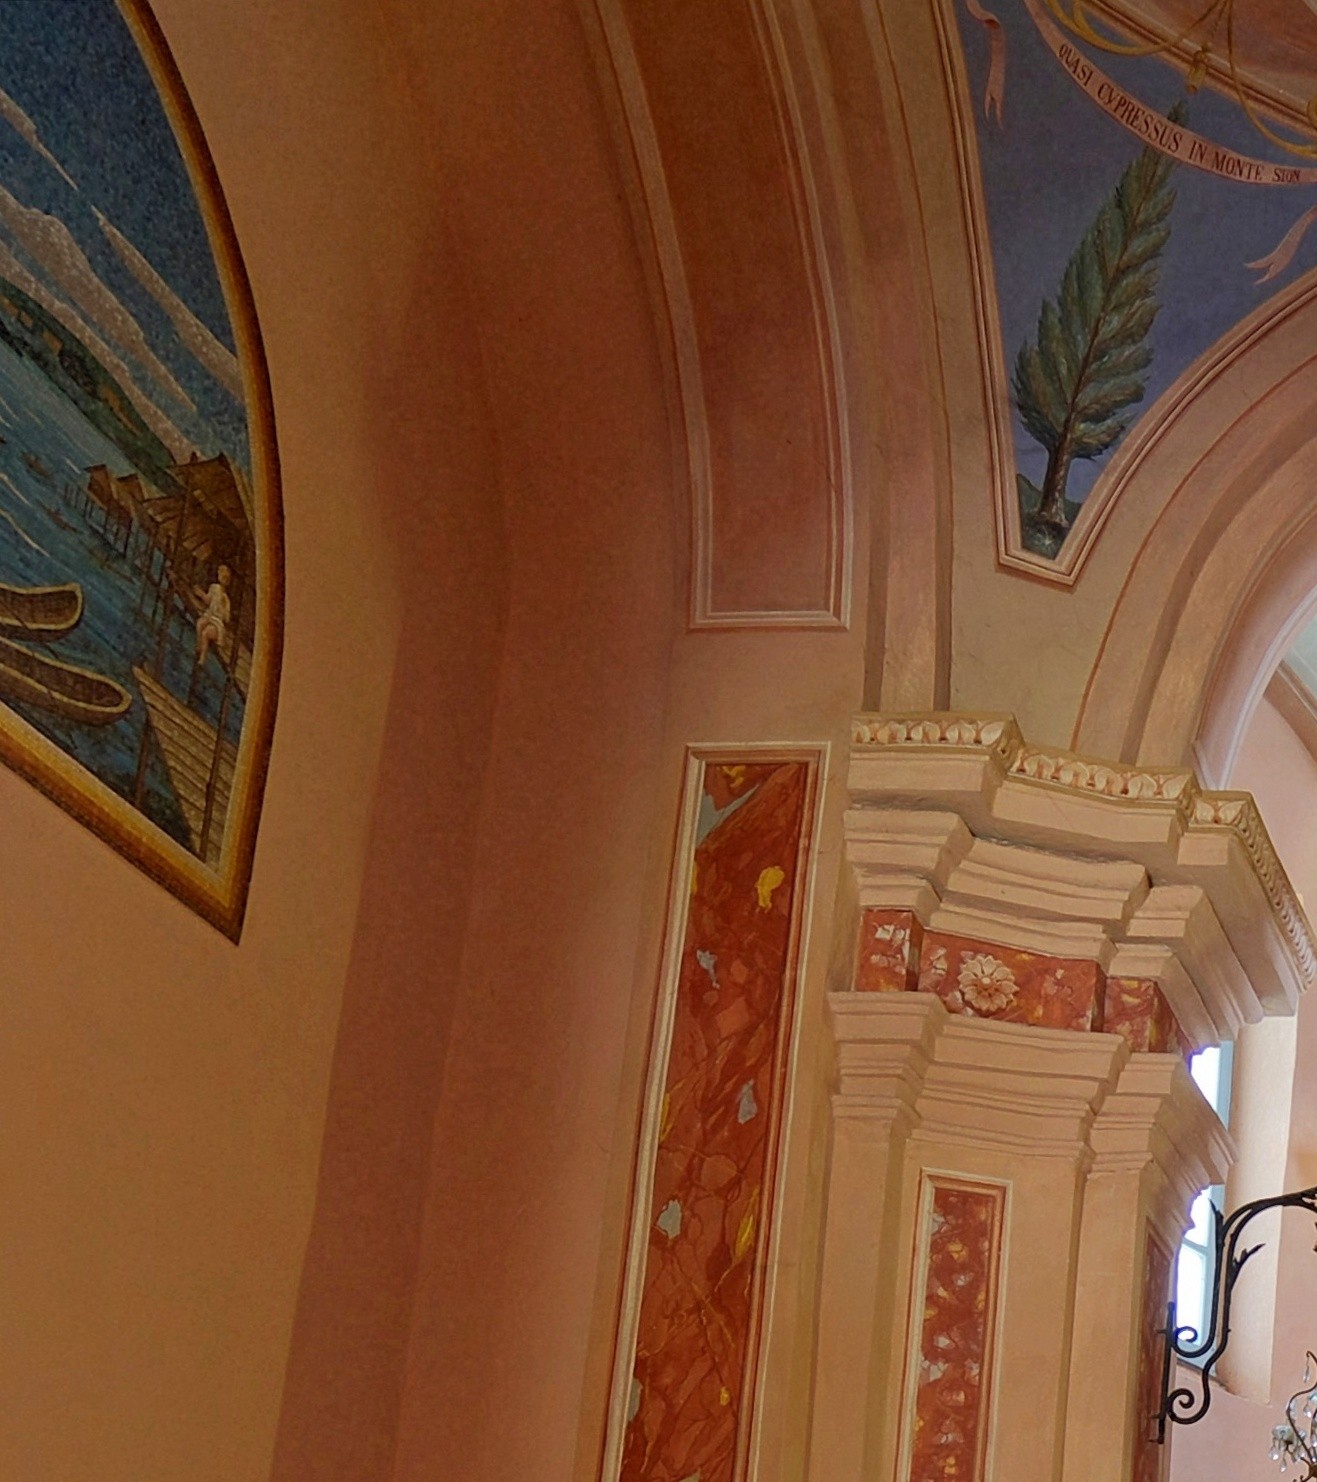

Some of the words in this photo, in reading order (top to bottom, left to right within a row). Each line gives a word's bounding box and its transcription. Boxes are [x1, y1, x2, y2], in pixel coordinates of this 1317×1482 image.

[1059, 43, 1093, 87] QUASI
[1188, 141, 1208, 161] IN
[1213, 151, 1264, 182] MONTE
